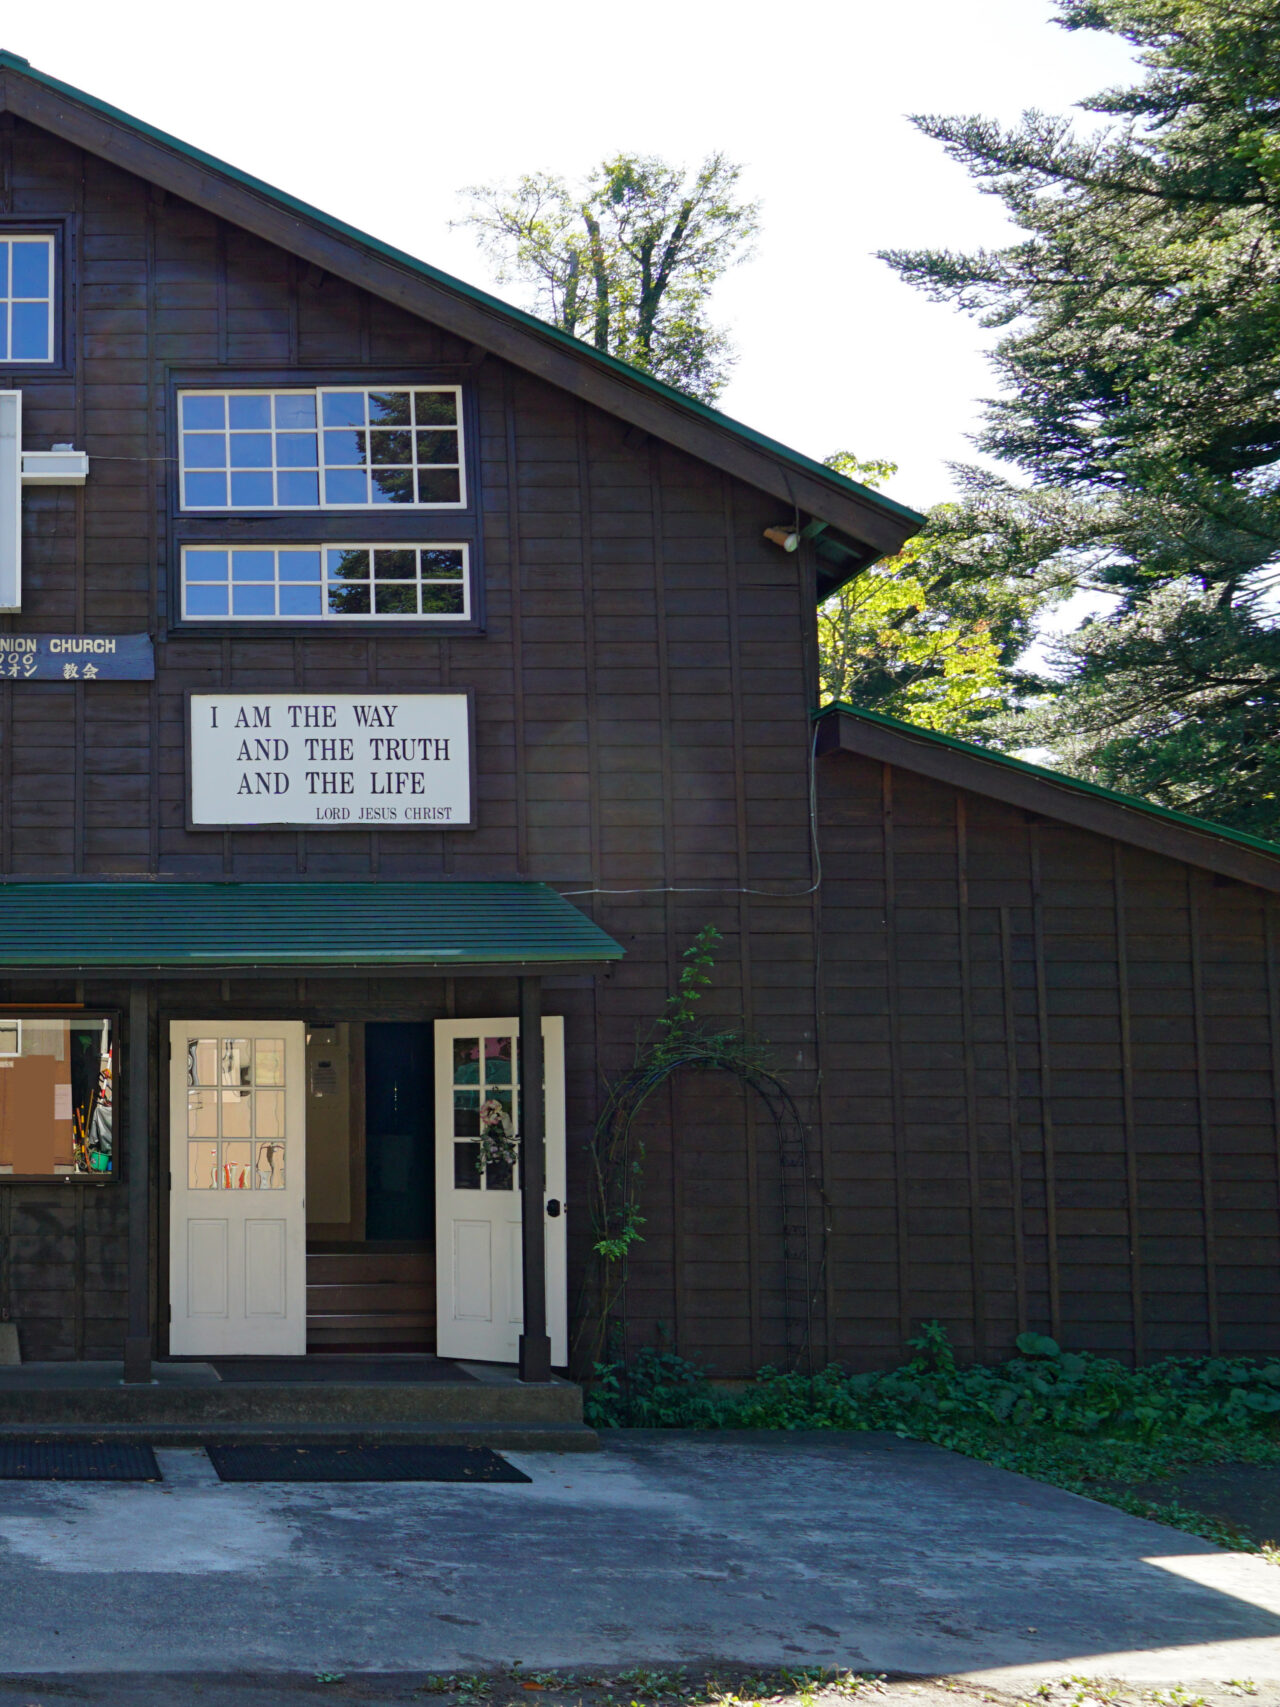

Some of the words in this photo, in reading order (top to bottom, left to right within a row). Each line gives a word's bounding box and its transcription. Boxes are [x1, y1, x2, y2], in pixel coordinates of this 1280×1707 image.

[49, 638, 116, 653] CHURCH
[62, 662, 100, 679] 教会
[210, 706, 219, 728] I
[234, 705, 272, 729] AM
[287, 705, 337, 728] THE
[352, 705, 399, 728] WAY
[236, 738, 289, 761] AND
[304, 738, 354, 761] THE
[369, 738, 451, 761] TRUTH
[236, 771, 290, 795] AND
[305, 771, 355, 795] THE
[370, 771, 425, 795] LIFE
[316, 807, 351, 820] LORD
[358, 807, 398, 820] JESUS
[404, 806, 453, 820] CHRIST
